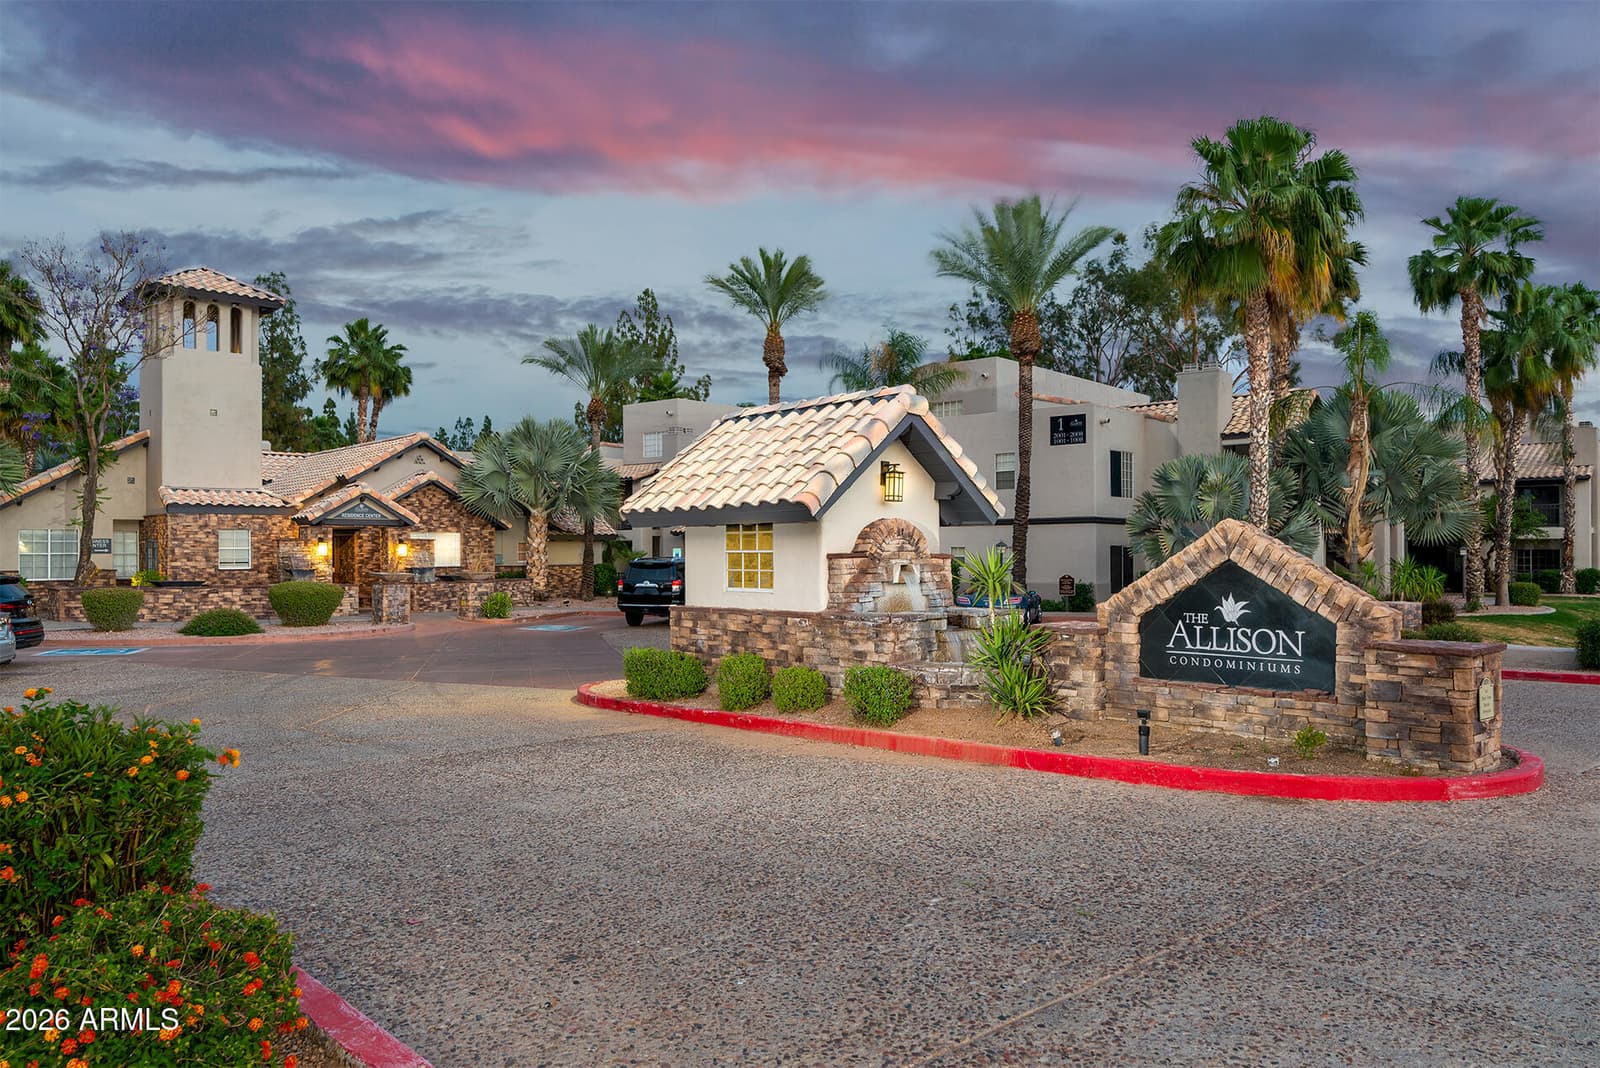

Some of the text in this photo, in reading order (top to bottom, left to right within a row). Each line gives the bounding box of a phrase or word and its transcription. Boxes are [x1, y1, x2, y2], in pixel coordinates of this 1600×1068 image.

[1057, 418, 1064, 431] 1
[1183, 612, 1209, 624] THE
[1165, 619, 1306, 657] ALLISON
[1169, 655, 1301, 675] CONDOMINIUMS
